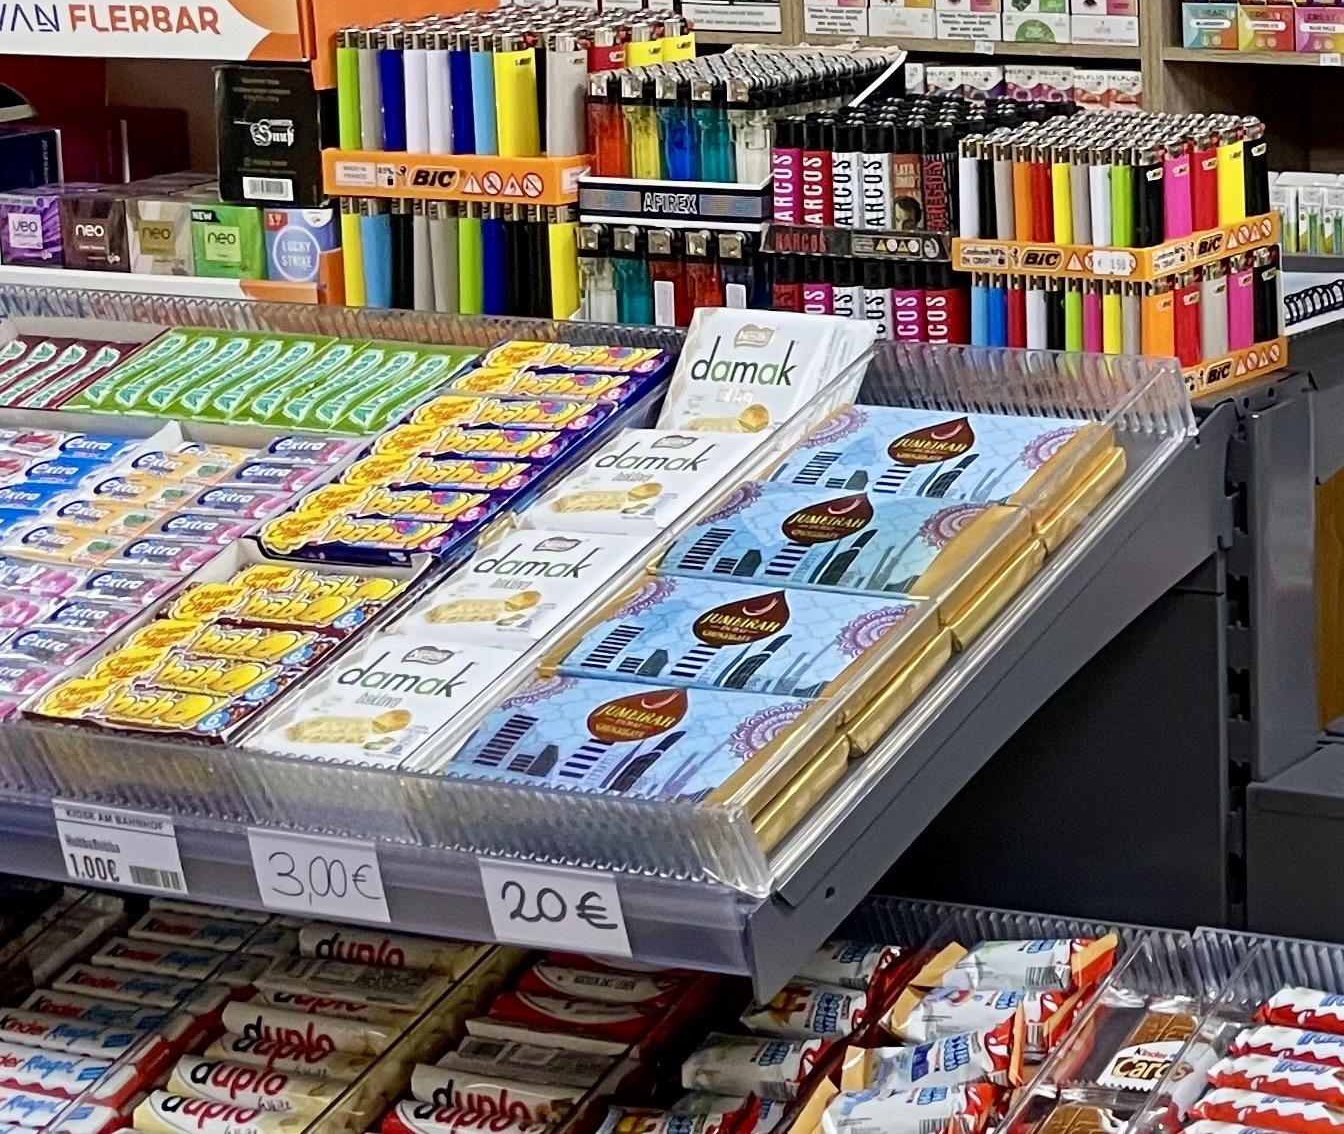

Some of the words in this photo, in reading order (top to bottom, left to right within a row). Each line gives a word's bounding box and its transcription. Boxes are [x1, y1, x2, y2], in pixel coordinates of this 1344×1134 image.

[68, 3, 222, 35] FLERBAR
[412, 169, 456, 188] BIC
[773, 154, 794, 223] ARCOS
[642, 192, 699, 215] AFIREX
[192, 210, 212, 220] NEW
[75, 224, 105, 237] neo
[141, 227, 171, 241] neo
[206, 231, 236, 246] neo
[281, 240, 311, 253] LUCKY
[775, 231, 827, 253] NARCOS
[1196, 233, 1223, 254] BIC
[281, 255, 312, 268] STRIKE
[1024, 252, 1060, 266] BIC
[691, 336, 798, 389] damak
[63, 437, 112, 452] extra
[141, 454, 184, 471] extra
[595, 442, 716, 473] damak
[30, 462, 79, 477] extra
[0, 488, 42, 502] extra
[102, 480, 147, 495] extra
[66, 504, 110, 518] extra
[701, 610, 783, 635] JUMEIRAH
[337, 651, 479, 698] damak
[600, 703, 675, 729] JUMEIRAH
[115, 815, 164, 831] BAHNHOF
[70, 853, 121, 883] 1,00€
[268, 850, 381, 907] 3,00€
[190, 1059, 288, 1099] duplo
[161, 1093, 260, 1129] duplo
